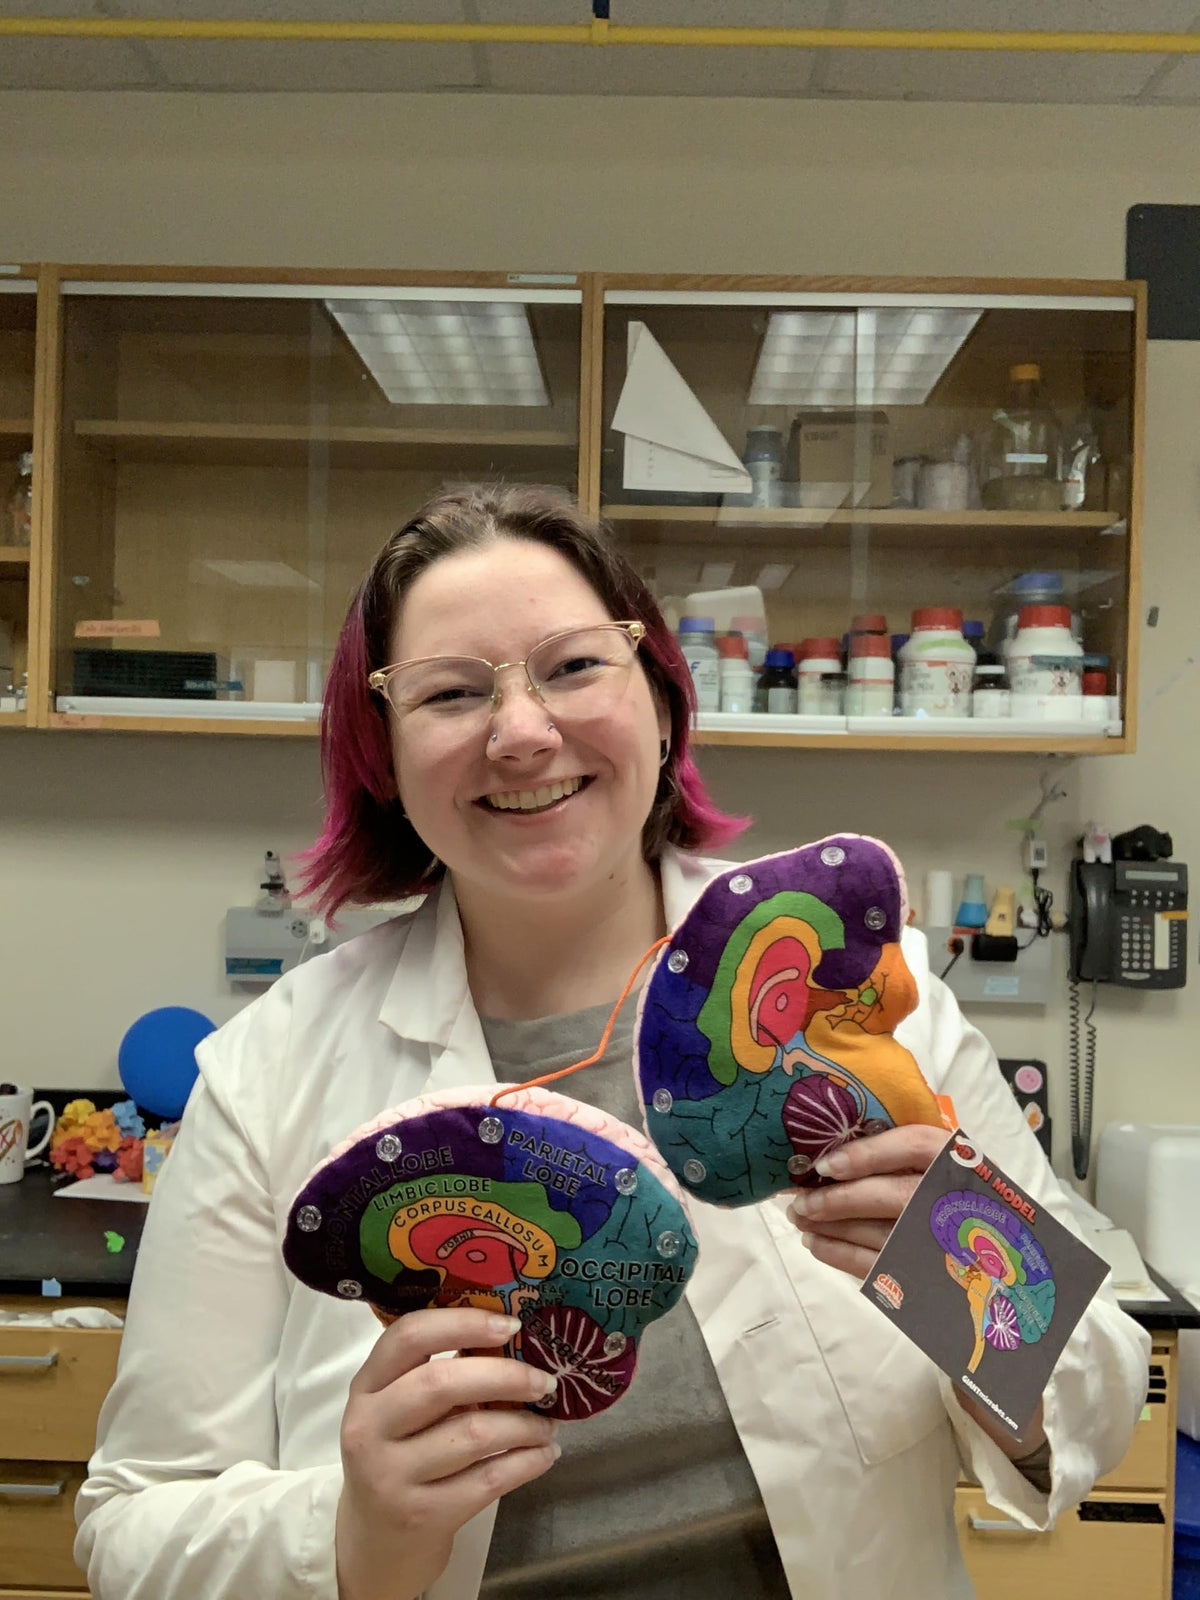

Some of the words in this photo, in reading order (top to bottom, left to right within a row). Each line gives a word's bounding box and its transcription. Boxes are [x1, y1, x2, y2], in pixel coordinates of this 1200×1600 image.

[508, 1130, 606, 1186] PARIETAL
[523, 1160, 580, 1198] LOBE
[326, 1167, 391, 1270] FRONTAL
[389, 1146, 454, 1180] LOBE
[373, 1182, 437, 1212] LIMBIC
[443, 1178, 492, 1193] LOBE
[992, 1177, 1036, 1225] MODEL
[394, 1199, 467, 1228] CORPUS
[471, 1204, 549, 1268] CALLOSUM
[442, 1229, 476, 1252] FORNIX
[518, 1283, 564, 1294] PINEAL
[560, 1257, 686, 1283] OCCIPITAL
[593, 1286, 654, 1309] LOBE
[517, 1307, 623, 1394] CEREBELLUM
[962, 1375, 1019, 1430] GIANTmicrobes.com
